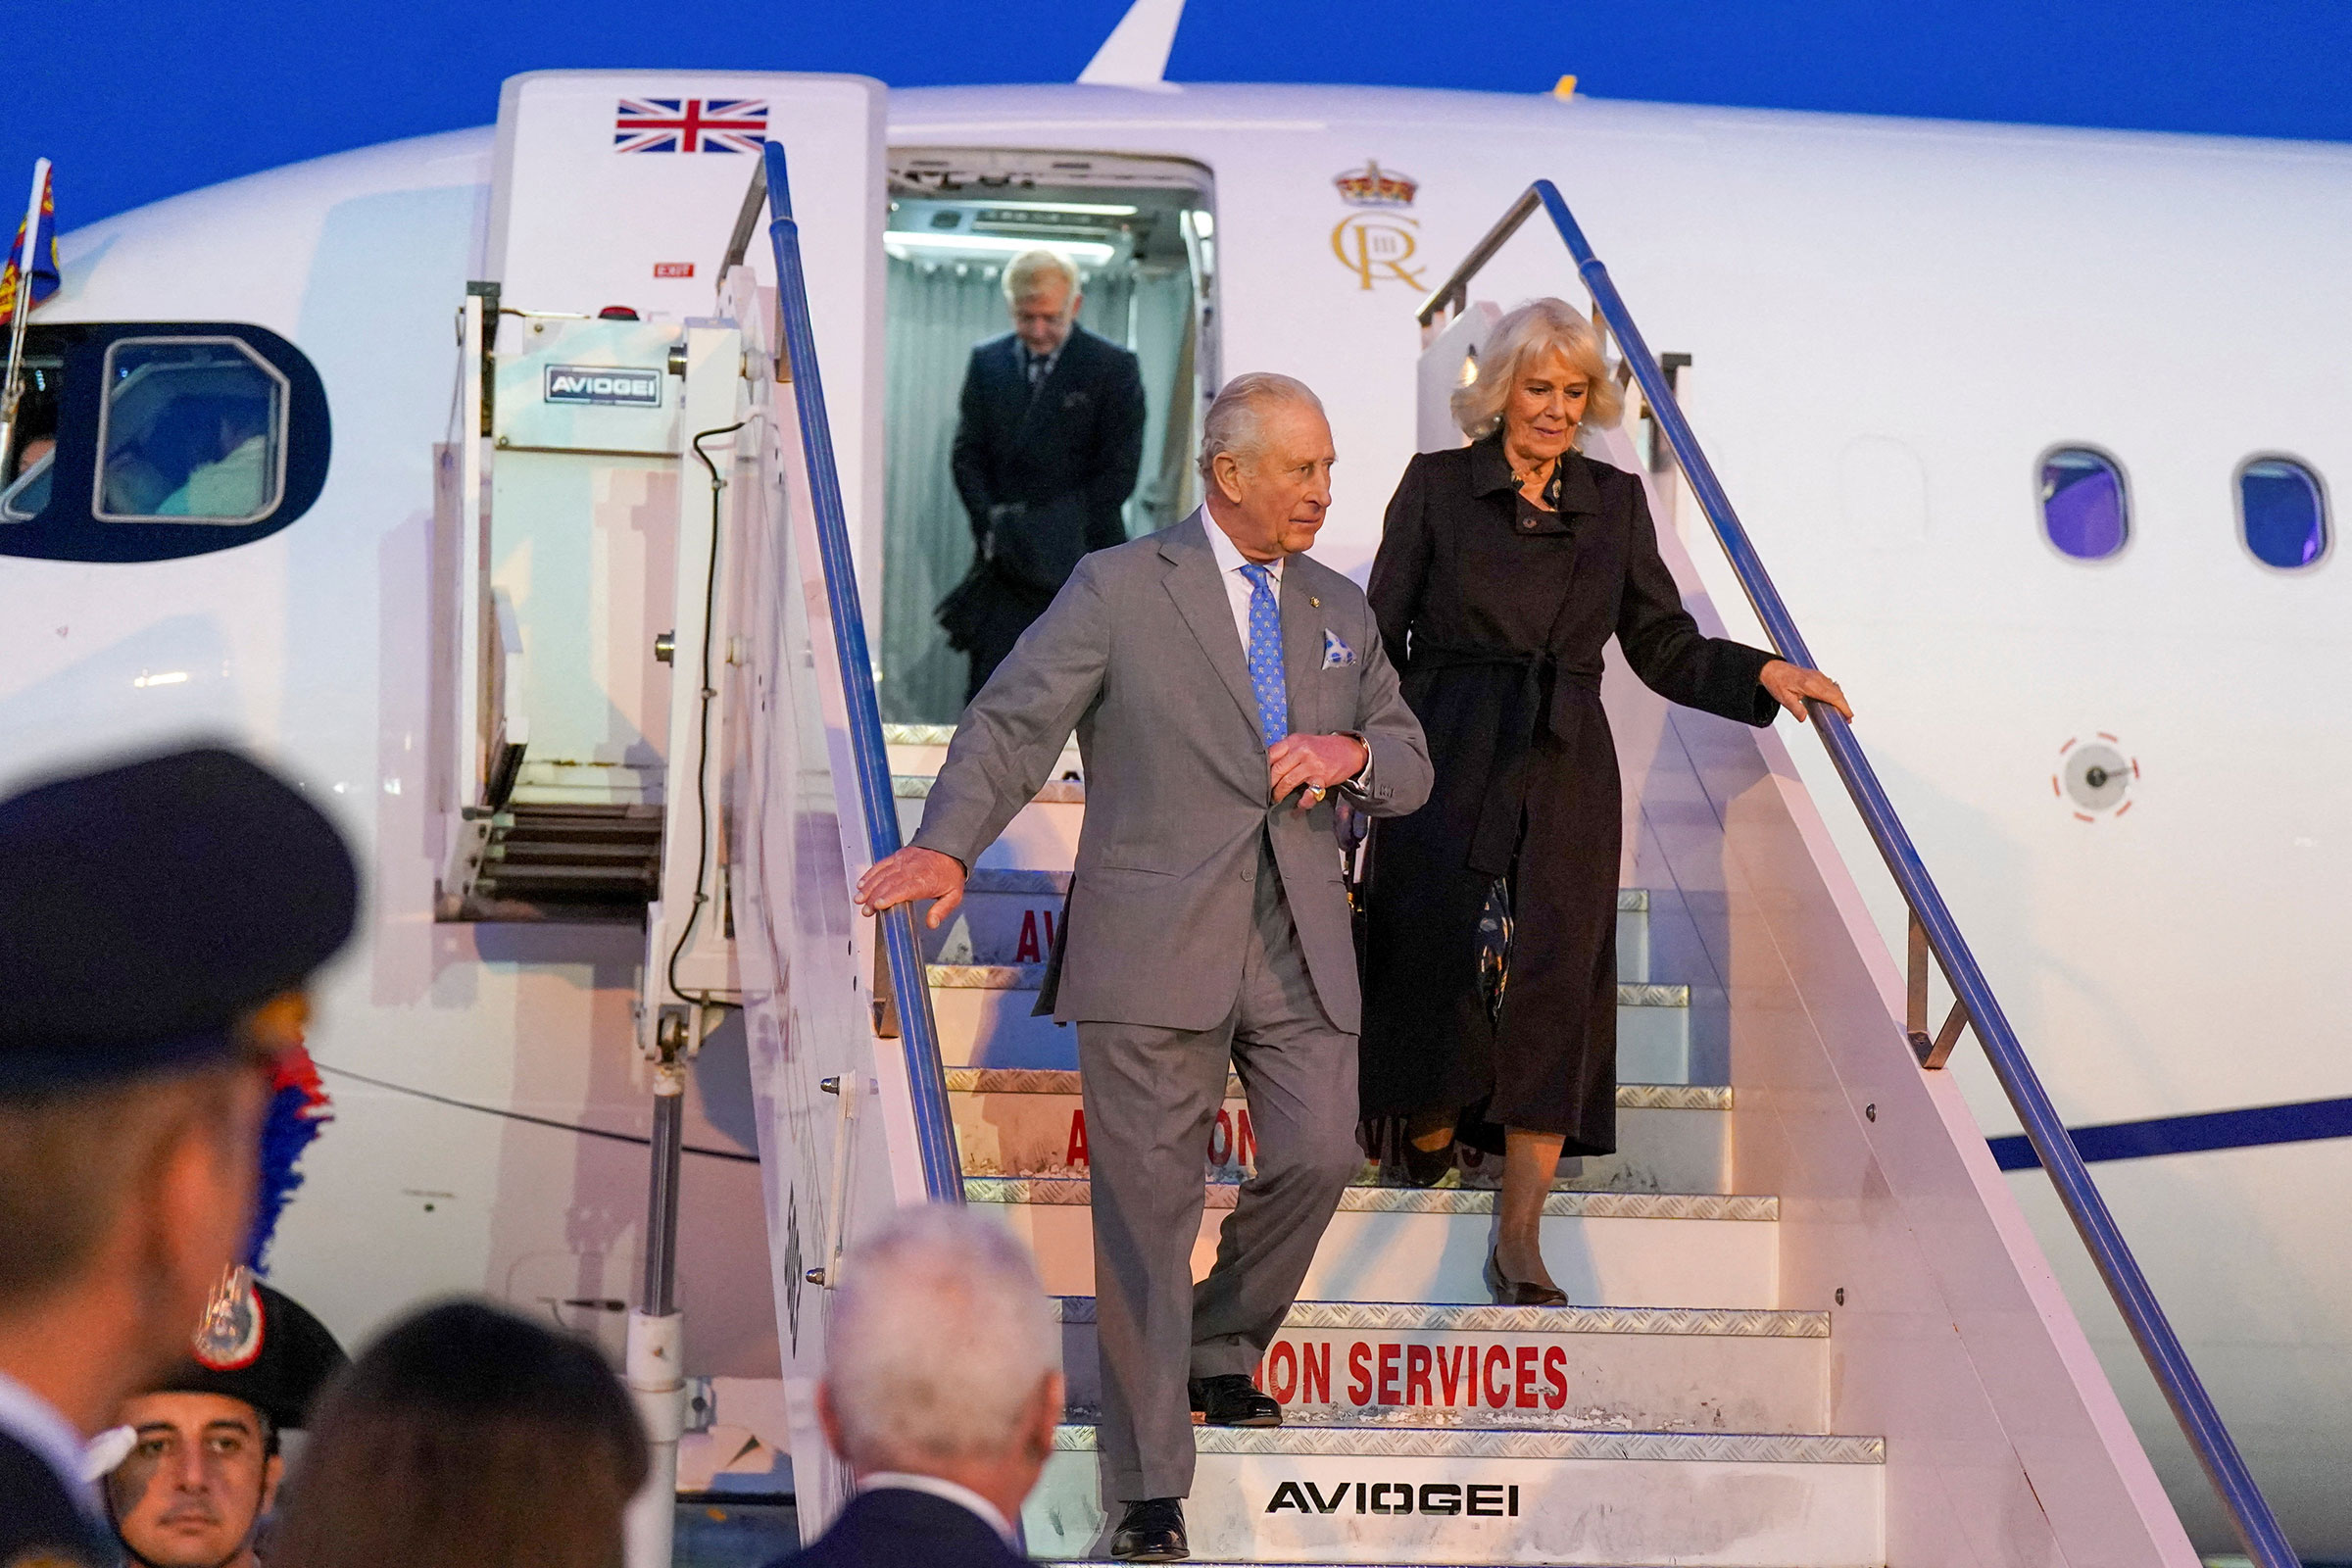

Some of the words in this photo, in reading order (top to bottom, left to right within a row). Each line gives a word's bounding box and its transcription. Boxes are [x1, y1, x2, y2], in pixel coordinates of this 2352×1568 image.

[551, 375, 656, 397] AVIOGEI
[1348, 1342, 1568, 1410] SERVICES
[1264, 1481, 1519, 1517] AVIOGEI
